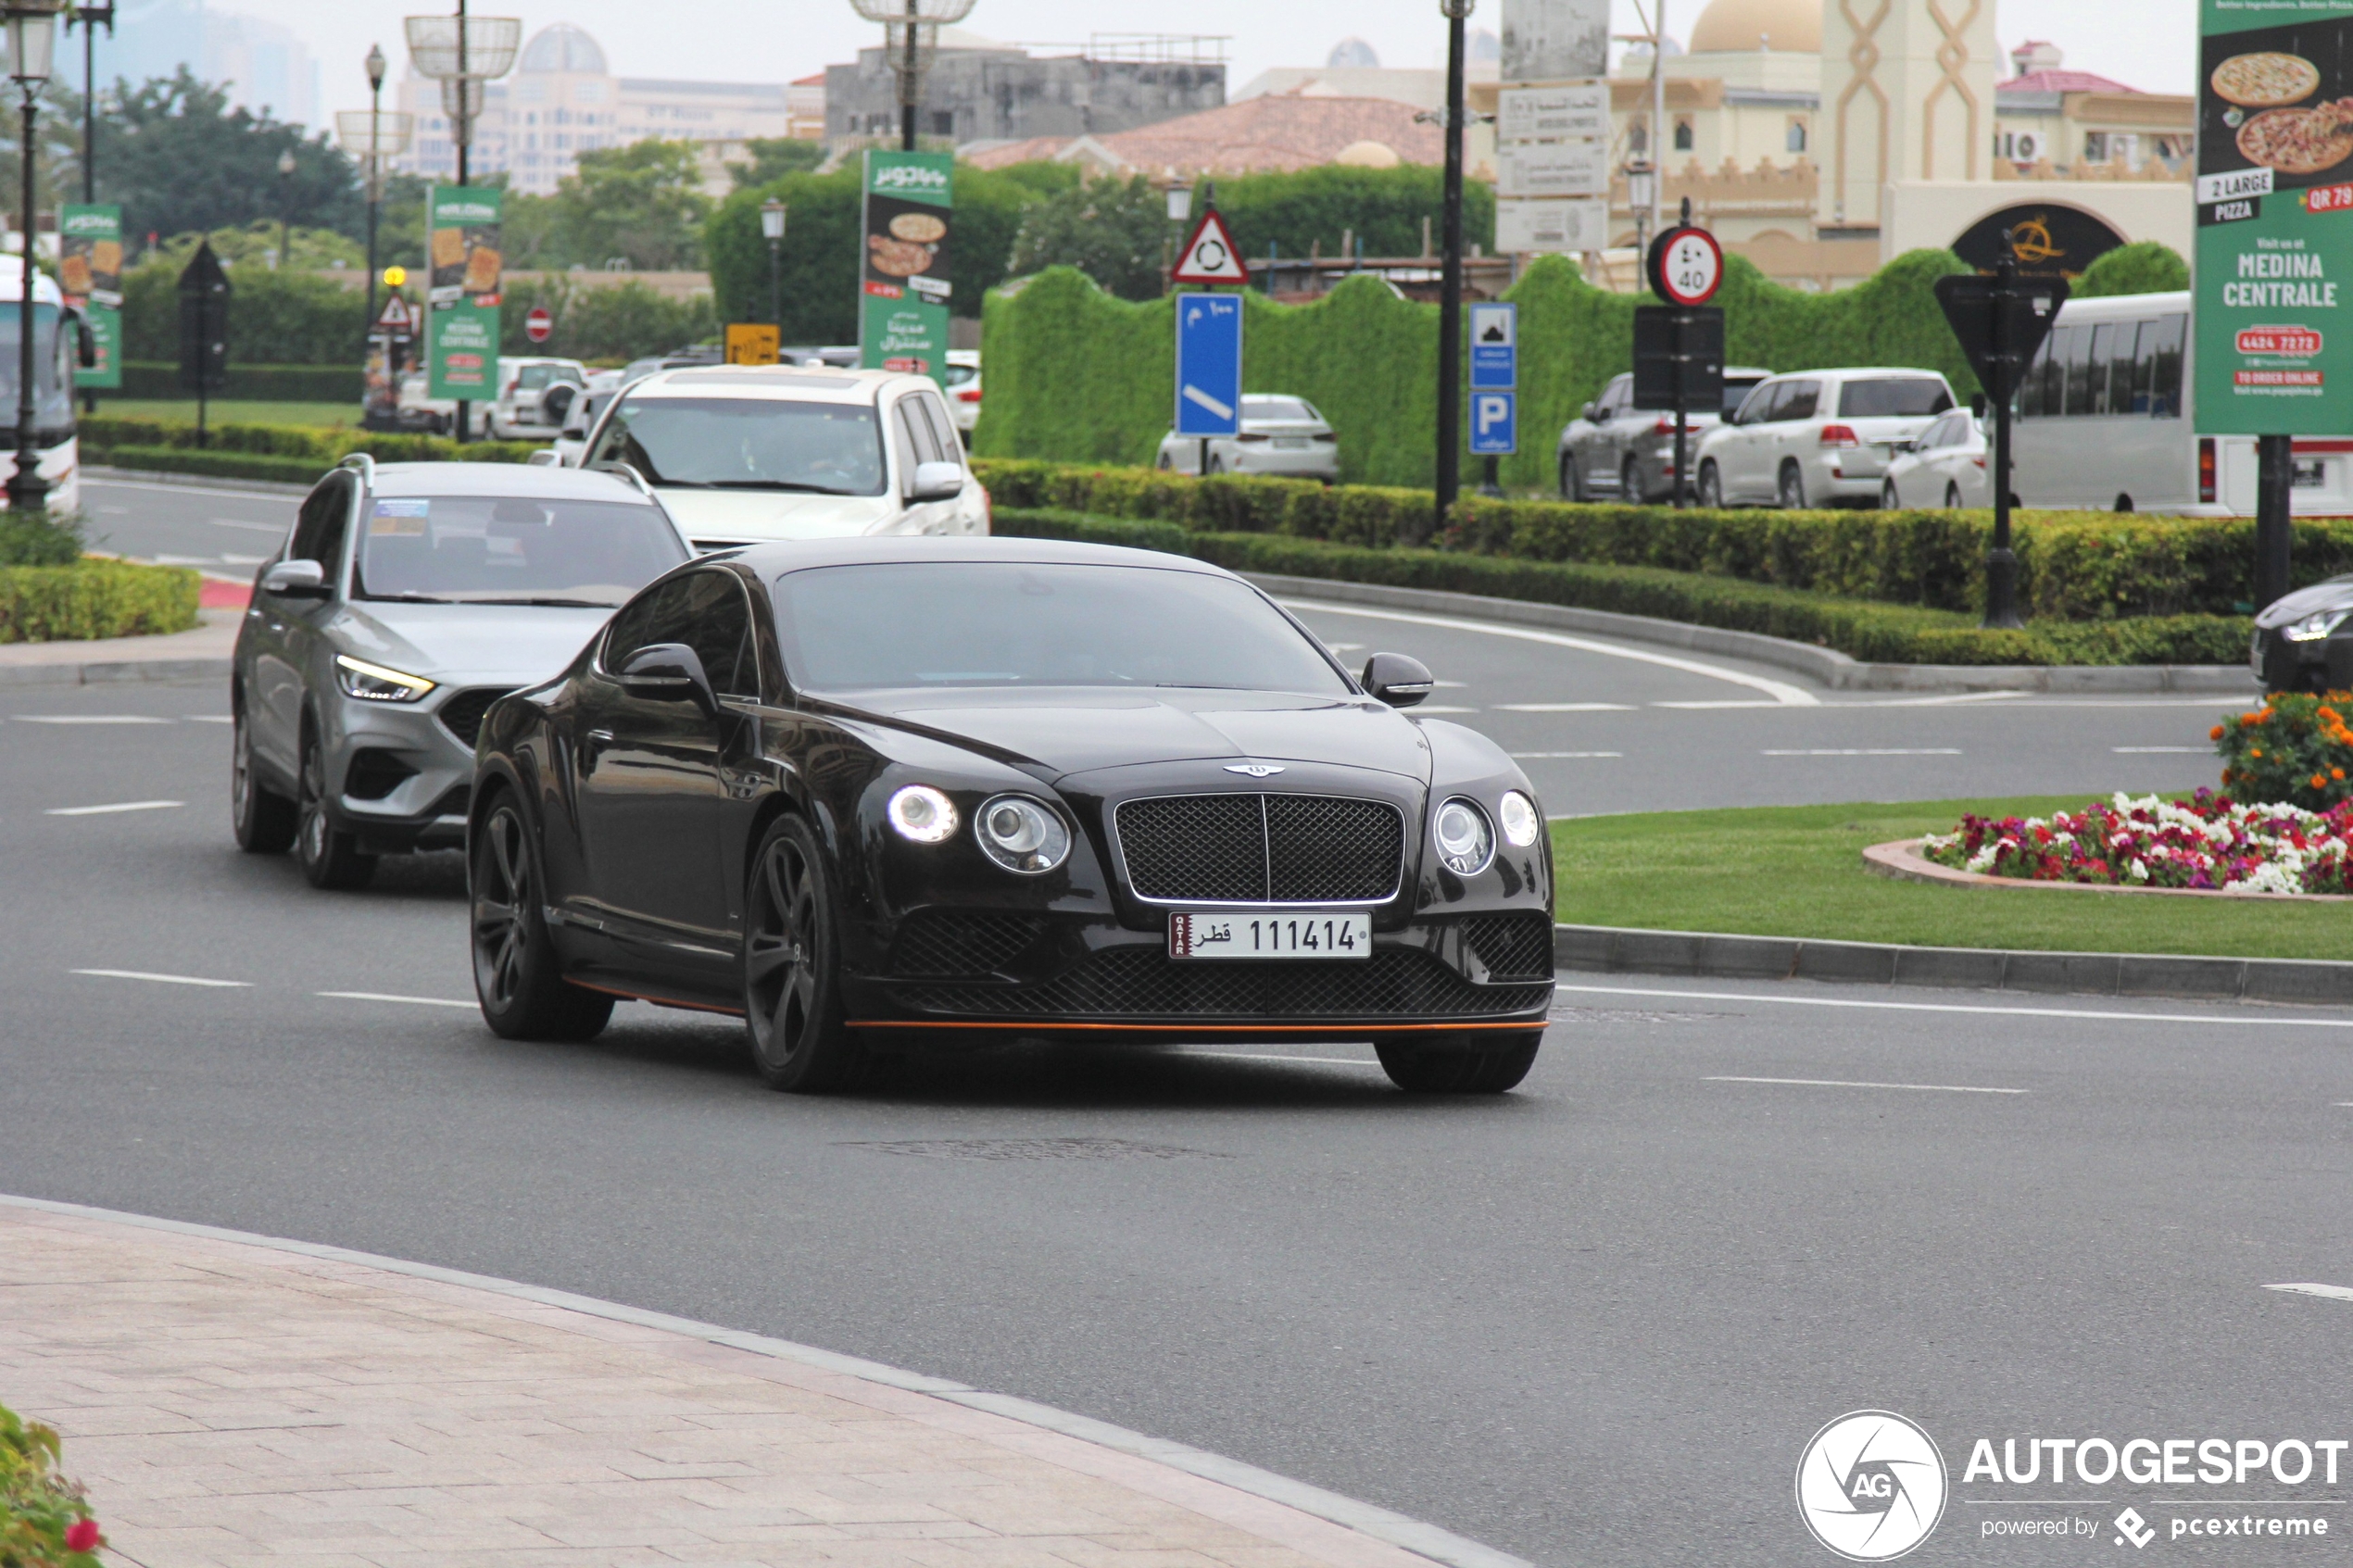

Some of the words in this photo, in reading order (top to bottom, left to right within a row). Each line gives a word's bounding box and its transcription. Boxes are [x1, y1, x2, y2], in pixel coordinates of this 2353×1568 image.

[2212, 180, 2221, 197] 2
[2224, 172, 2270, 195] LARGE
[2309, 189, 2332, 209] QR
[2333, 186, 2353, 207] 79
[2214, 200, 2253, 221] PIZZA
[2256, 237, 2279, 249] Visit
[2280, 240, 2292, 249] us
[2293, 238, 2305, 249] at
[2237, 253, 2323, 278] MEDINA
[1678, 270, 1705, 290] 40
[2223, 282, 2338, 307] CENTRALE
[2242, 335, 2275, 349] 4424
[2280, 335, 2314, 350] 7272
[2238, 371, 2251, 384] TO
[2252, 371, 2283, 384] ORDER
[2284, 371, 2319, 384] ONLINE
[1478, 395, 1508, 435] P
[1176, 916, 1184, 955] QATAR
[1193, 922, 1231, 947] قطر
[1250, 920, 1354, 950] 111414
